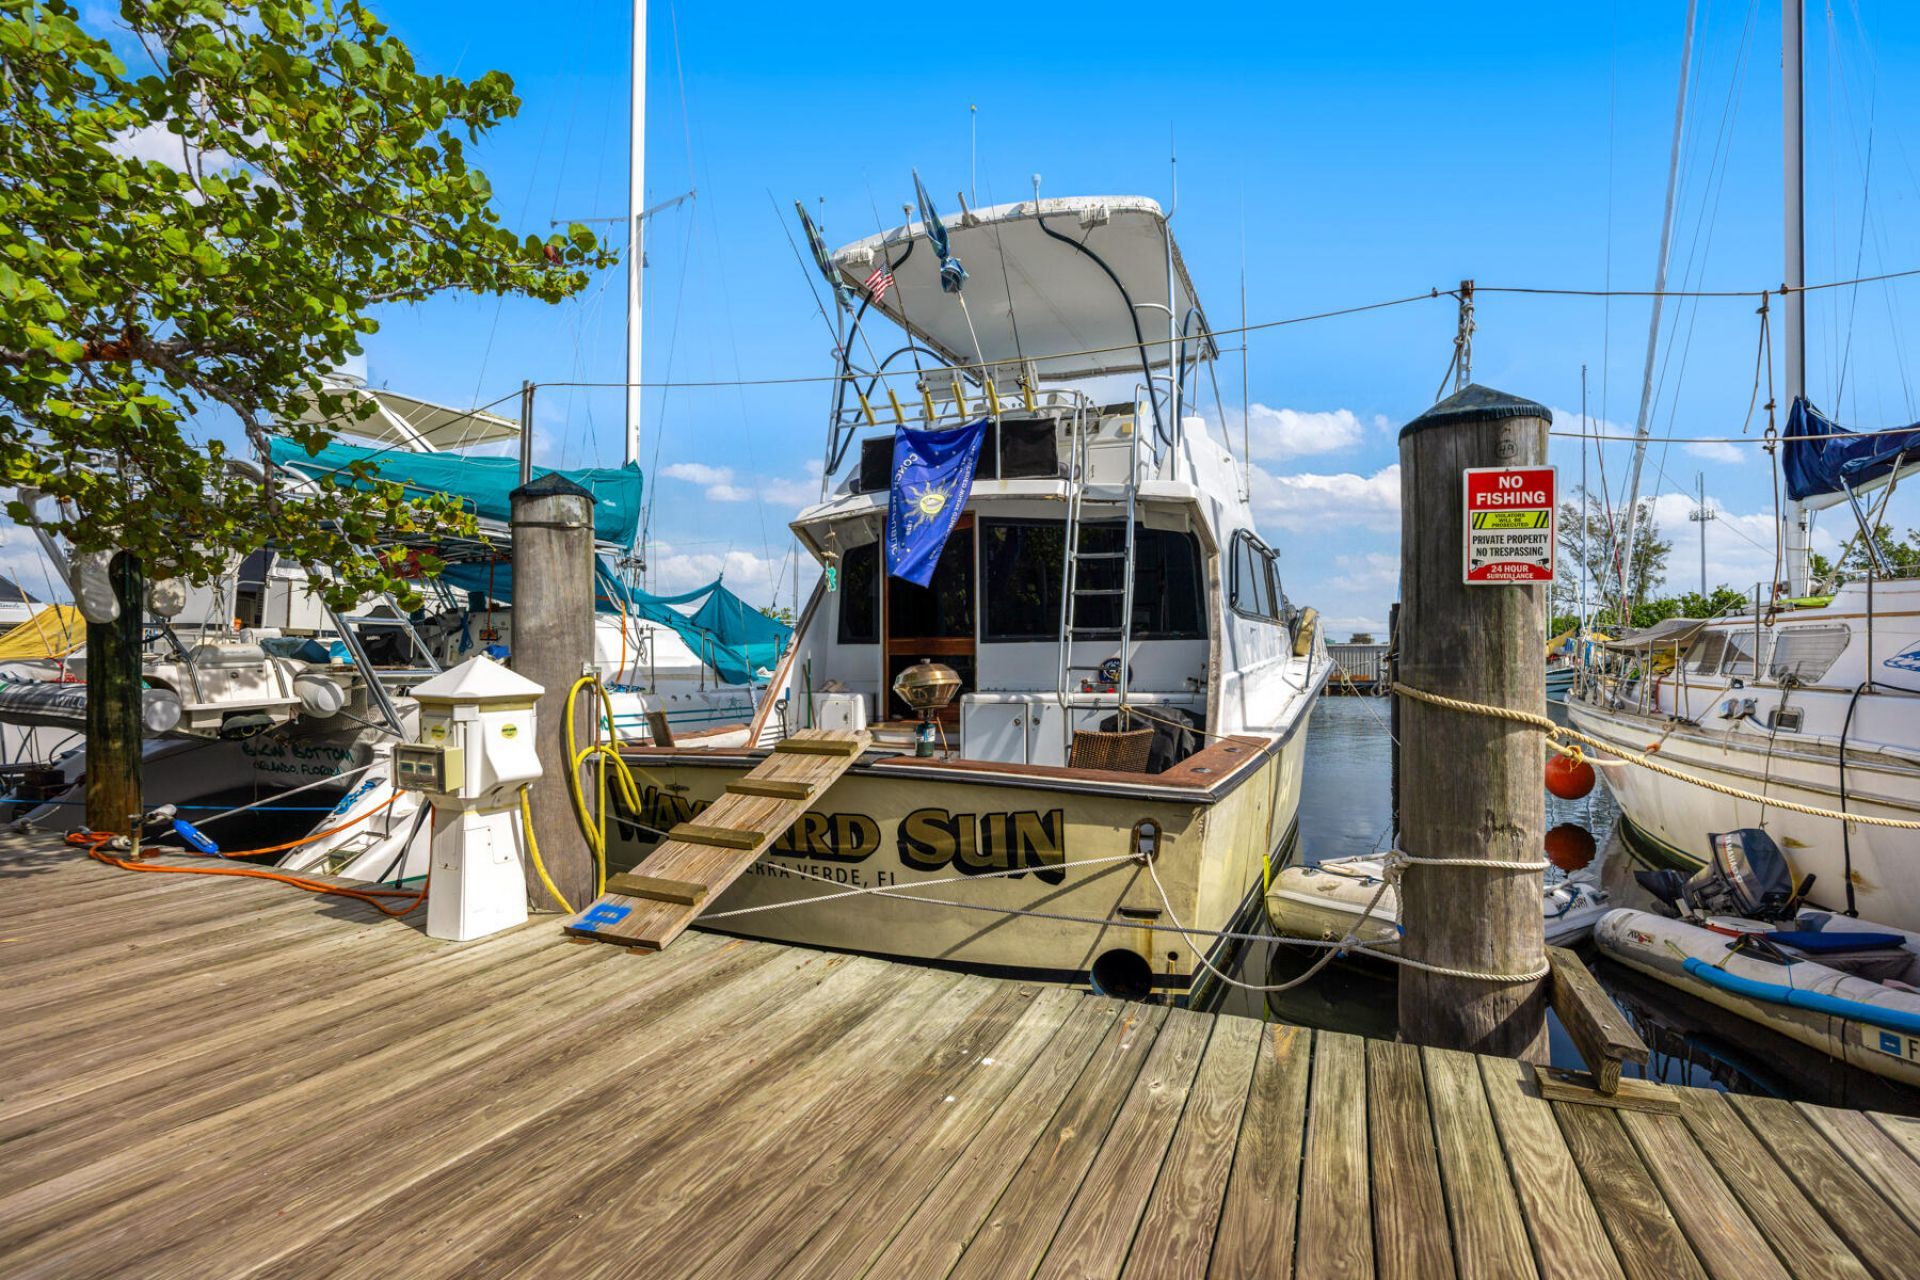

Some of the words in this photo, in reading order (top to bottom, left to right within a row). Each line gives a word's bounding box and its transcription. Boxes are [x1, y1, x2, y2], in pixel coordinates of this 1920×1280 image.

[1498, 475, 1523, 489] NO
[1476, 491, 1546, 506] FISHING
[1472, 535, 1504, 545] PRIVATE
[1506, 533, 1548, 545] PROPERTY
[1476, 547, 1488, 557] NO
[1490, 546, 1543, 557] TRESPASSING
[1491, 565, 1502, 573] 24
[1504, 564, 1529, 573] HOUR
[292, 743, 355, 763] BOTTOM
[607, 774, 881, 864] WAYRD
[898, 808, 1066, 885] SUN
